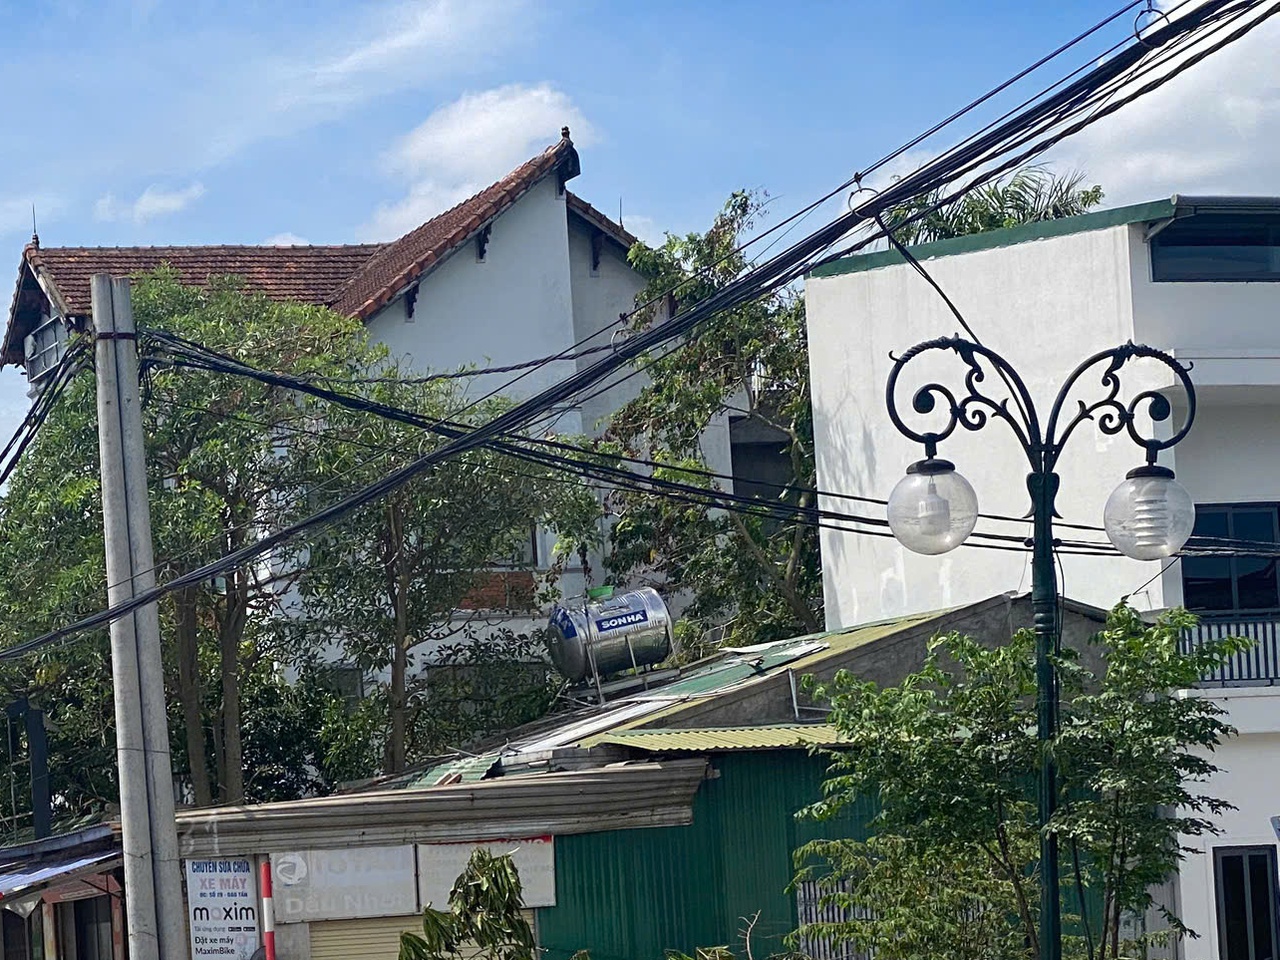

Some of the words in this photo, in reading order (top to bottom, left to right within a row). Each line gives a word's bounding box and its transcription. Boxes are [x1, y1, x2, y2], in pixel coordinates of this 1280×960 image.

[601, 613, 644, 629] SONHA
[200, 878, 216, 890] XE
[220, 875, 247, 890] MÁY
[193, 902, 255, 920] maxim
[195, 936, 208, 945] Đặt
[219, 936, 234, 945] máy
[195, 946, 235, 955] MaximBike
